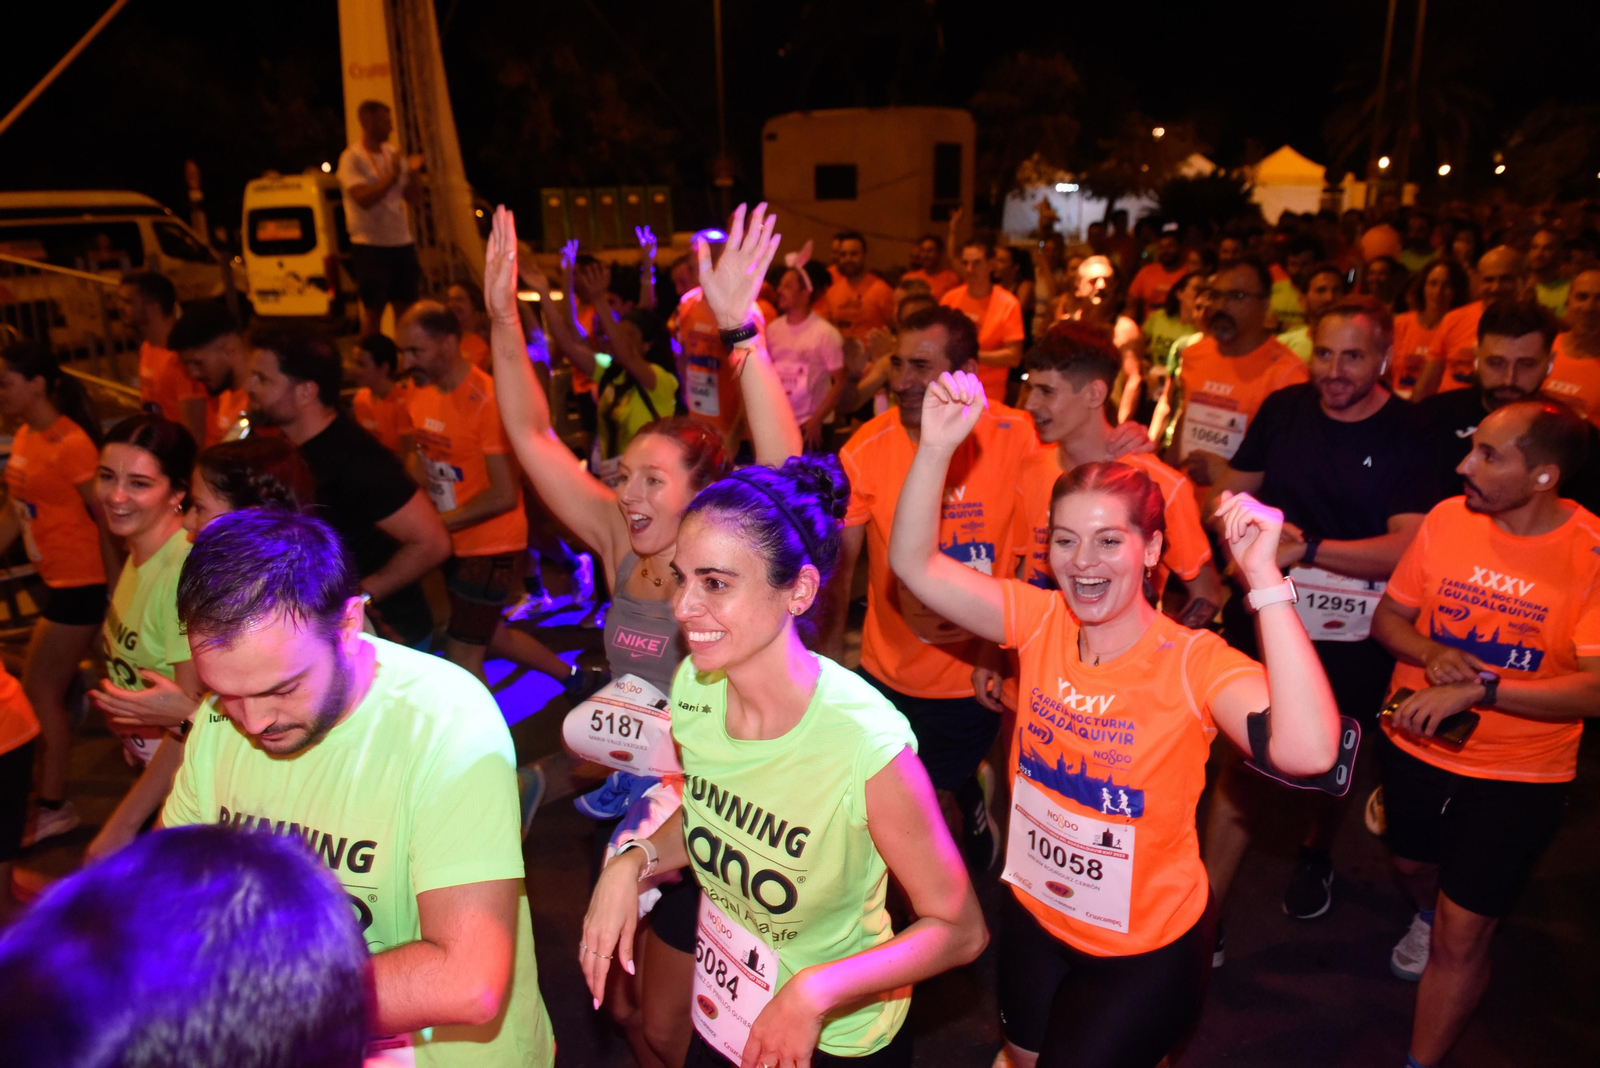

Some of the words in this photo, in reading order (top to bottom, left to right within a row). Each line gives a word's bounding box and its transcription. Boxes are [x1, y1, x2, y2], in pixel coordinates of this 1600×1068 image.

[1441, 578, 1487, 597] CARRERA
[1491, 592, 1549, 613] NOCTURNA
[1468, 565, 1536, 597] XXXV
[1306, 592, 1367, 615] 12951
[1444, 588, 1546, 623] GUADALQUIVIR
[617, 632, 661, 652] NIKE
[1058, 677, 1116, 715] XXXV
[590, 709, 644, 740] 5187
[1032, 701, 1135, 746] GUADALQUIVIR
[1070, 712, 1136, 731] NOCTURNA
[1027, 829, 1104, 881] 10058
[695, 935, 740, 1002] 5084
